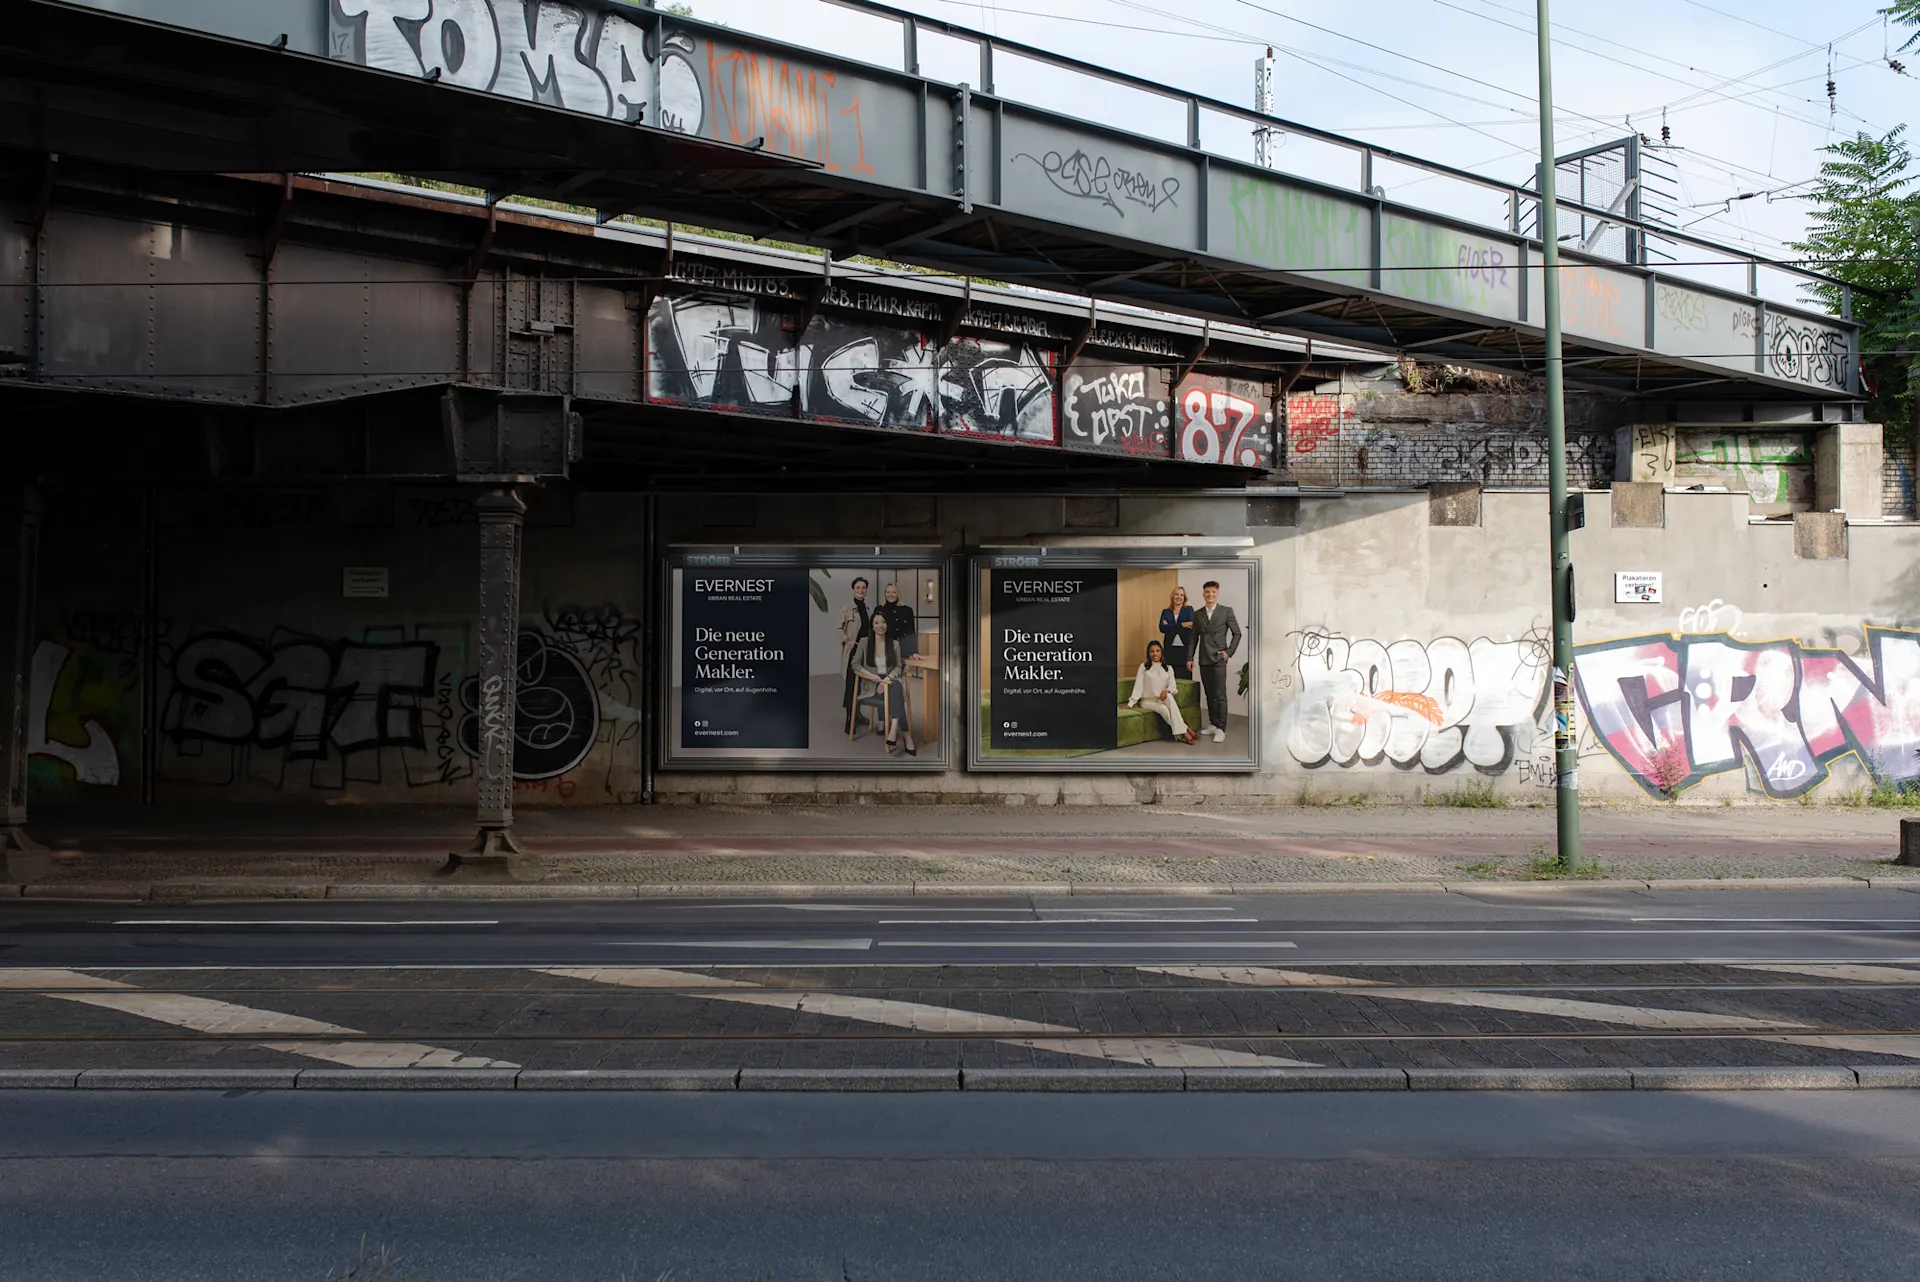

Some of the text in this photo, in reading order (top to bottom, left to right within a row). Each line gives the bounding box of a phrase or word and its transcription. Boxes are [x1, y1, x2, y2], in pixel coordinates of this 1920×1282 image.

[695, 579, 775, 592] EVERNEST
[1003, 580, 1083, 594] EVERNEST
[695, 627, 765, 642] Die neue
[1003, 628, 1074, 644] Die neue
[694, 645, 785, 661] Generation
[1003, 646, 1093, 662] Generation
[695, 663, 755, 679] Makler.
[1003, 665, 1064, 681] Makler.
